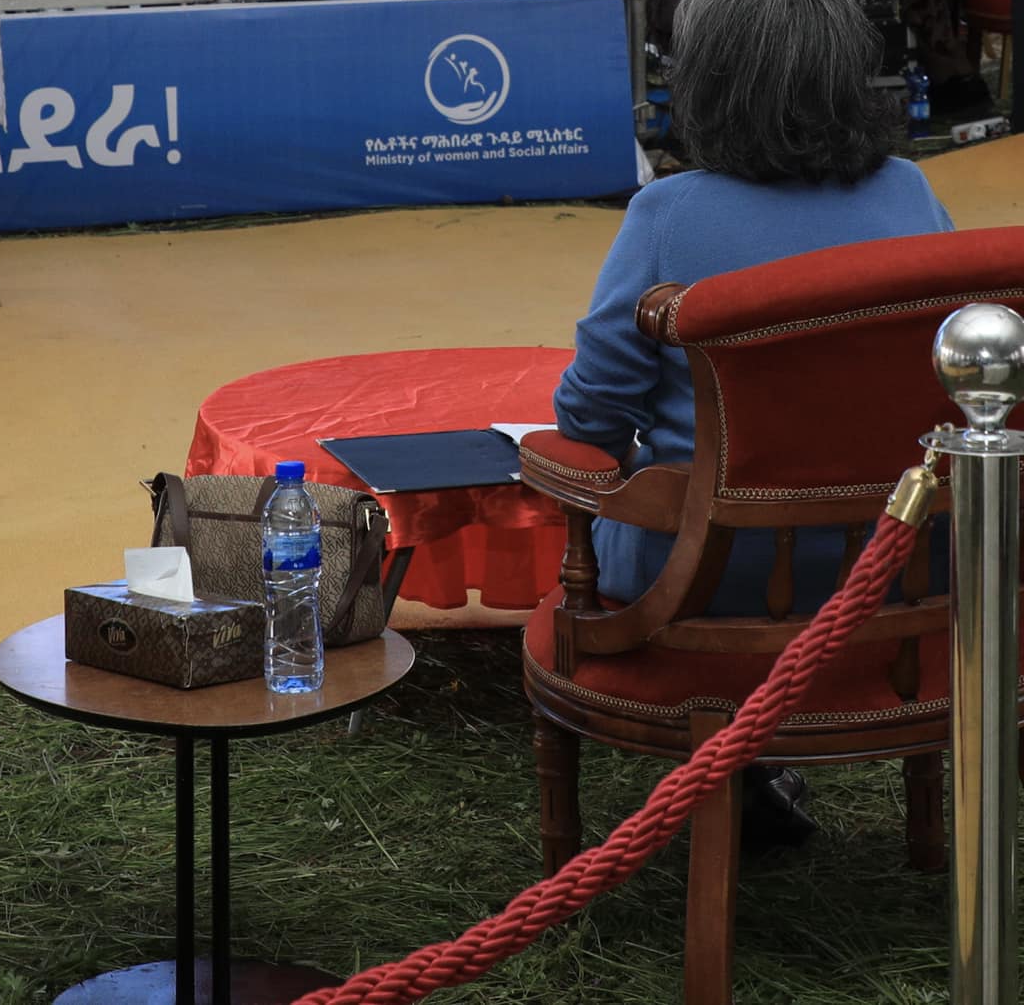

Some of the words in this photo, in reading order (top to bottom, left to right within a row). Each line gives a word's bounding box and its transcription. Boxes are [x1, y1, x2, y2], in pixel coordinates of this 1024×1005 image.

[365, 153, 415, 166] Ministry
[418, 151, 432, 163] of
[434, 150, 480, 162] women
[482, 147, 506, 159] and
[508, 145, 546, 158] Social
[548, 141, 590, 156] Affairs
